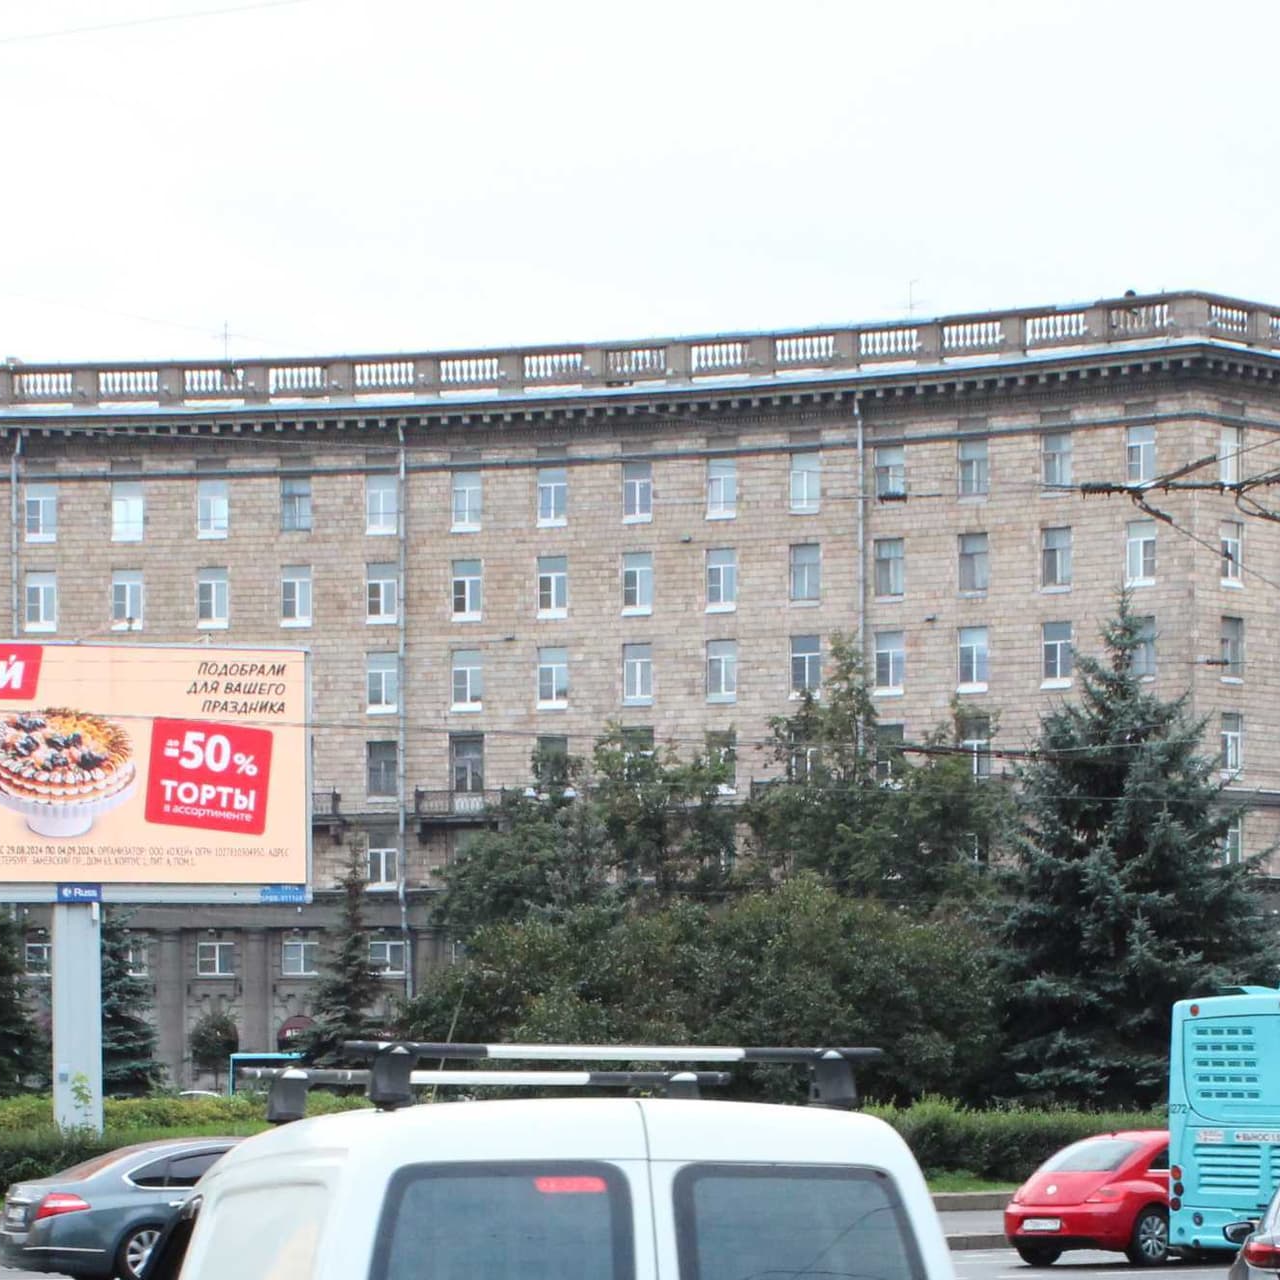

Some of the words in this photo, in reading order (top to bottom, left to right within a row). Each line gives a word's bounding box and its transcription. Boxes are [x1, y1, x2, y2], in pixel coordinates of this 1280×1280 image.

[198, 662, 286, 677] ПОДОБРАЛИ
[187, 681, 219, 694] ДЛЯ
[224, 682, 286, 695] ВАШЕГО
[201, 700, 286, 714] ПРАЗДНИКА
[164, 731, 258, 776] -50%
[161, 779, 256, 811] ТОРТЫ
[172, 805, 253, 821] ассортименте
[45, 847, 55, 855] ПО
